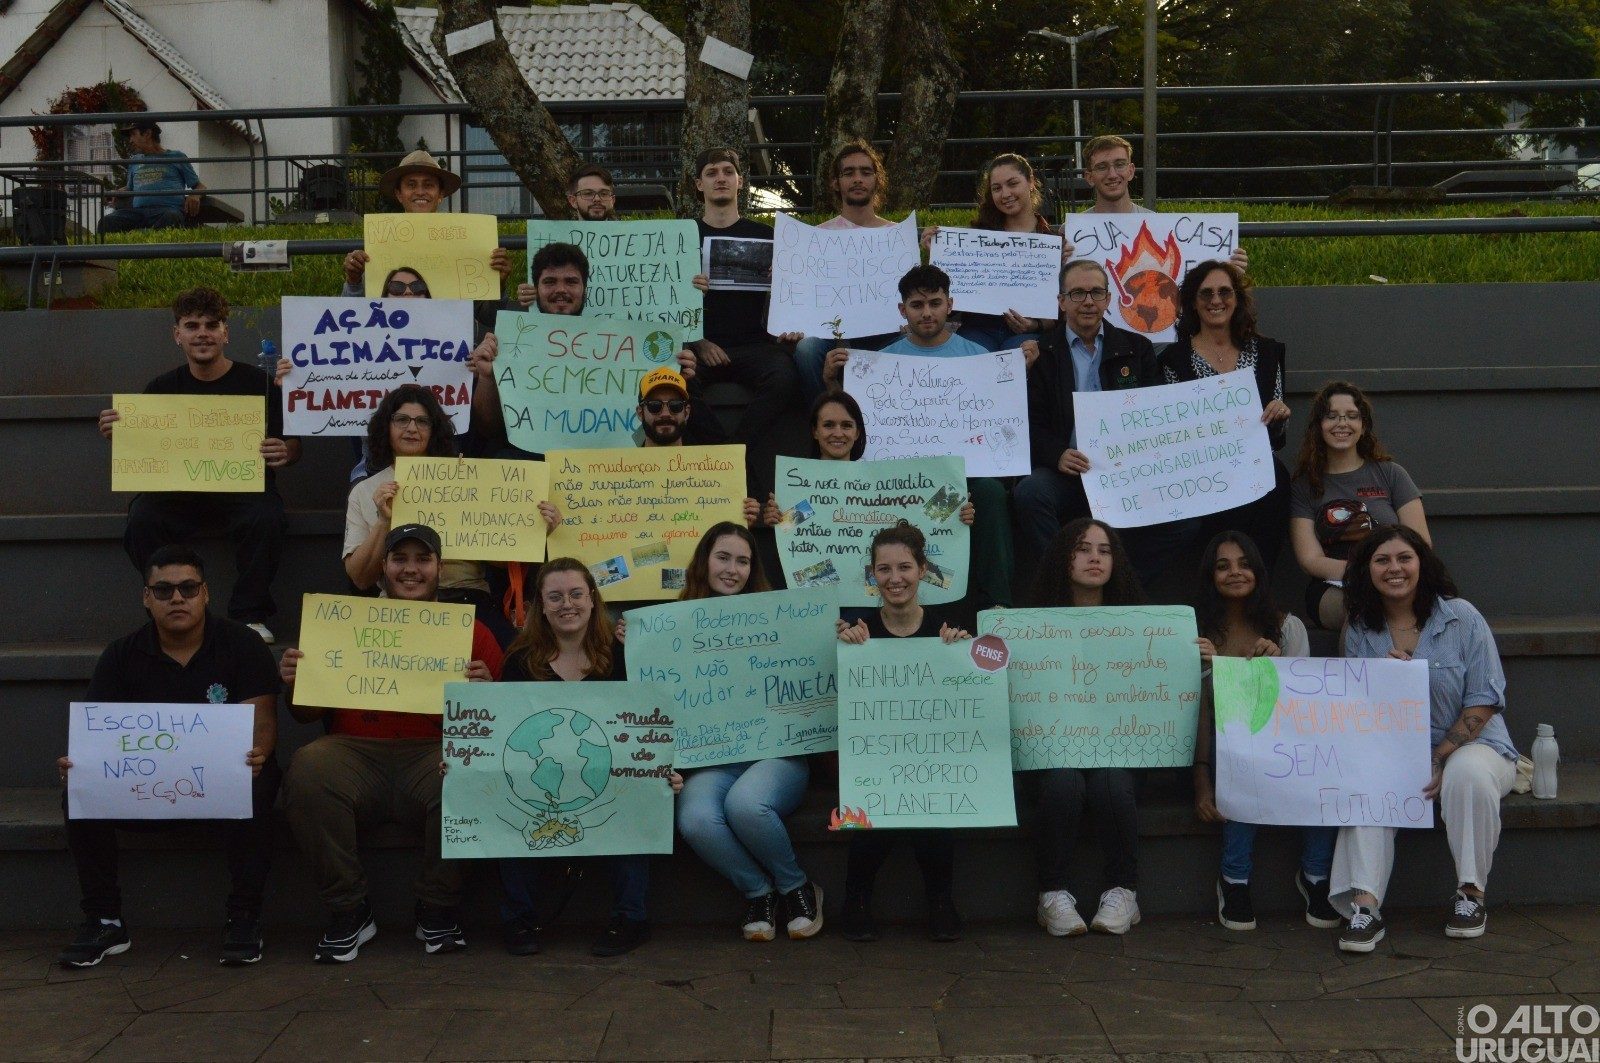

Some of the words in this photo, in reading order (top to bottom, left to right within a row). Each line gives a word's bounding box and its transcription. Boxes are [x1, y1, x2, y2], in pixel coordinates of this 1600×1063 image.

[366, 216, 415, 245] NÃO
[427, 225, 469, 242] EXISTE
[782, 222, 800, 249] O
[807, 225, 907, 256] AMANHÃ
[977, 233, 1011, 250] Fridays
[1008, 236, 1028, 249] For
[1027, 238, 1062, 251] Future
[1073, 220, 1130, 258] SUA
[1174, 216, 1233, 256] CASA
[676, 231, 688, 257] A
[776, 249, 841, 279] CORRE
[847, 252, 914, 279] RISCO
[455, 257, 491, 300] B
[586, 285, 659, 308] ROTEJA
[670, 285, 680, 306] A
[779, 278, 806, 306] DE
[313, 301, 410, 336] AÇÃO
[291, 333, 471, 369] CLIMÁTICA
[547, 329, 635, 363] SEJA
[346, 370, 359, 381] de
[498, 366, 517, 390] A
[647, 373, 683, 386] SHARK
[884, 361, 903, 387] A
[503, 404, 535, 432] DA
[1100, 418, 1110, 437] A
[1120, 385, 1252, 433] PRESERVAÇÃO
[1106, 444, 1125, 462] DA
[1127, 428, 1192, 456] NATUREZA
[1196, 422, 1206, 440] É
[1210, 419, 1229, 438] DE
[501, 464, 526, 483] VAI
[560, 456, 581, 475] As
[588, 456, 661, 476] mudanças
[1099, 438, 1247, 492] RESPONSABILIDADE
[553, 478, 584, 492] não
[588, 477, 656, 496] respeitam
[786, 467, 812, 488] Se
[813, 478, 841, 488] você
[844, 478, 872, 491] não
[875, 472, 937, 491] acredita
[402, 485, 480, 505] CONSEGUIR
[490, 486, 535, 504] FUGIR
[607, 493, 633, 507] não
[635, 495, 690, 510] respeitam
[694, 496, 732, 510] quem
[845, 493, 926, 510] mudanças
[1121, 494, 1144, 514] DE
[1152, 471, 1229, 502] TODOS
[417, 510, 447, 528] DAS
[644, 511, 666, 523] ou
[634, 532, 655, 541] ou
[793, 522, 834, 538] então
[837, 524, 864, 538] não
[928, 526, 954, 537] em
[787, 540, 828, 558] fatos,
[831, 543, 863, 555] nem
[315, 600, 353, 624] NÃO
[368, 606, 412, 625] DEIXE
[419, 609, 452, 627] QUE
[461, 612, 474, 629] O
[691, 606, 771, 631] Podemos
[775, 602, 829, 621] Mudar
[353, 626, 404, 648] VERDE
[691, 630, 782, 651] Sistema
[1078, 628, 1136, 641] coisas
[1142, 626, 1178, 653] que
[324, 649, 344, 670] SE
[362, 649, 451, 673] TRANSFORME
[747, 655, 819, 673] Podemos
[974, 644, 1005, 663] PENSE
[848, 661, 937, 689] NENHUMA
[940, 670, 995, 692] espécie
[1072, 653, 1102, 687] faz
[1284, 657, 1370, 698] SEM
[345, 674, 400, 696] CINZA
[744, 687, 758, 698] de
[1048, 691, 1060, 704] o
[1063, 690, 1098, 705] meio
[1105, 680, 1172, 705] ambiente
[84, 704, 210, 735] ESCOLHA
[445, 700, 498, 722] Uma
[847, 698, 988, 723] INTELIGENTE
[442, 722, 495, 741] ação
[636, 728, 676, 747] dia
[848, 729, 990, 756] DESTRUIRIA
[1062, 724, 1100, 738] uma
[444, 741, 497, 767] hoje...
[1263, 742, 1344, 780] SEM
[103, 756, 157, 780] NÃO
[610, 762, 674, 780] amanhã
[853, 775, 883, 788] seu
[887, 758, 979, 785] PRÓPRIO
[863, 791, 982, 818] PLANETA
[1317, 786, 1427, 825] FUTURO
